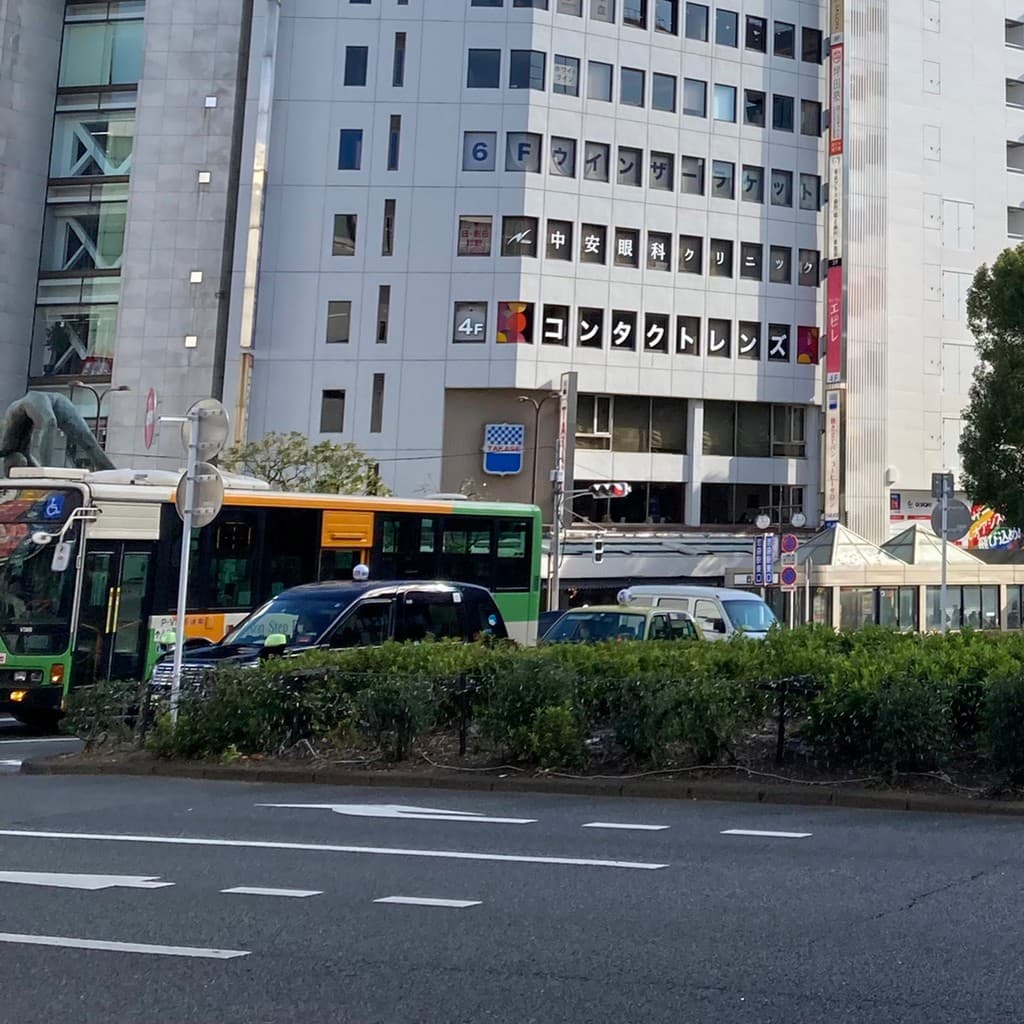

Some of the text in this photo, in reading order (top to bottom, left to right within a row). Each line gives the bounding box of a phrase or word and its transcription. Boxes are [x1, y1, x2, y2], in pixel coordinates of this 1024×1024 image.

[550, 230, 813, 275] 中安眼科クリニック
[457, 320, 483, 336] 4F
[545, 317, 788, 357] コンタクトレンズ
